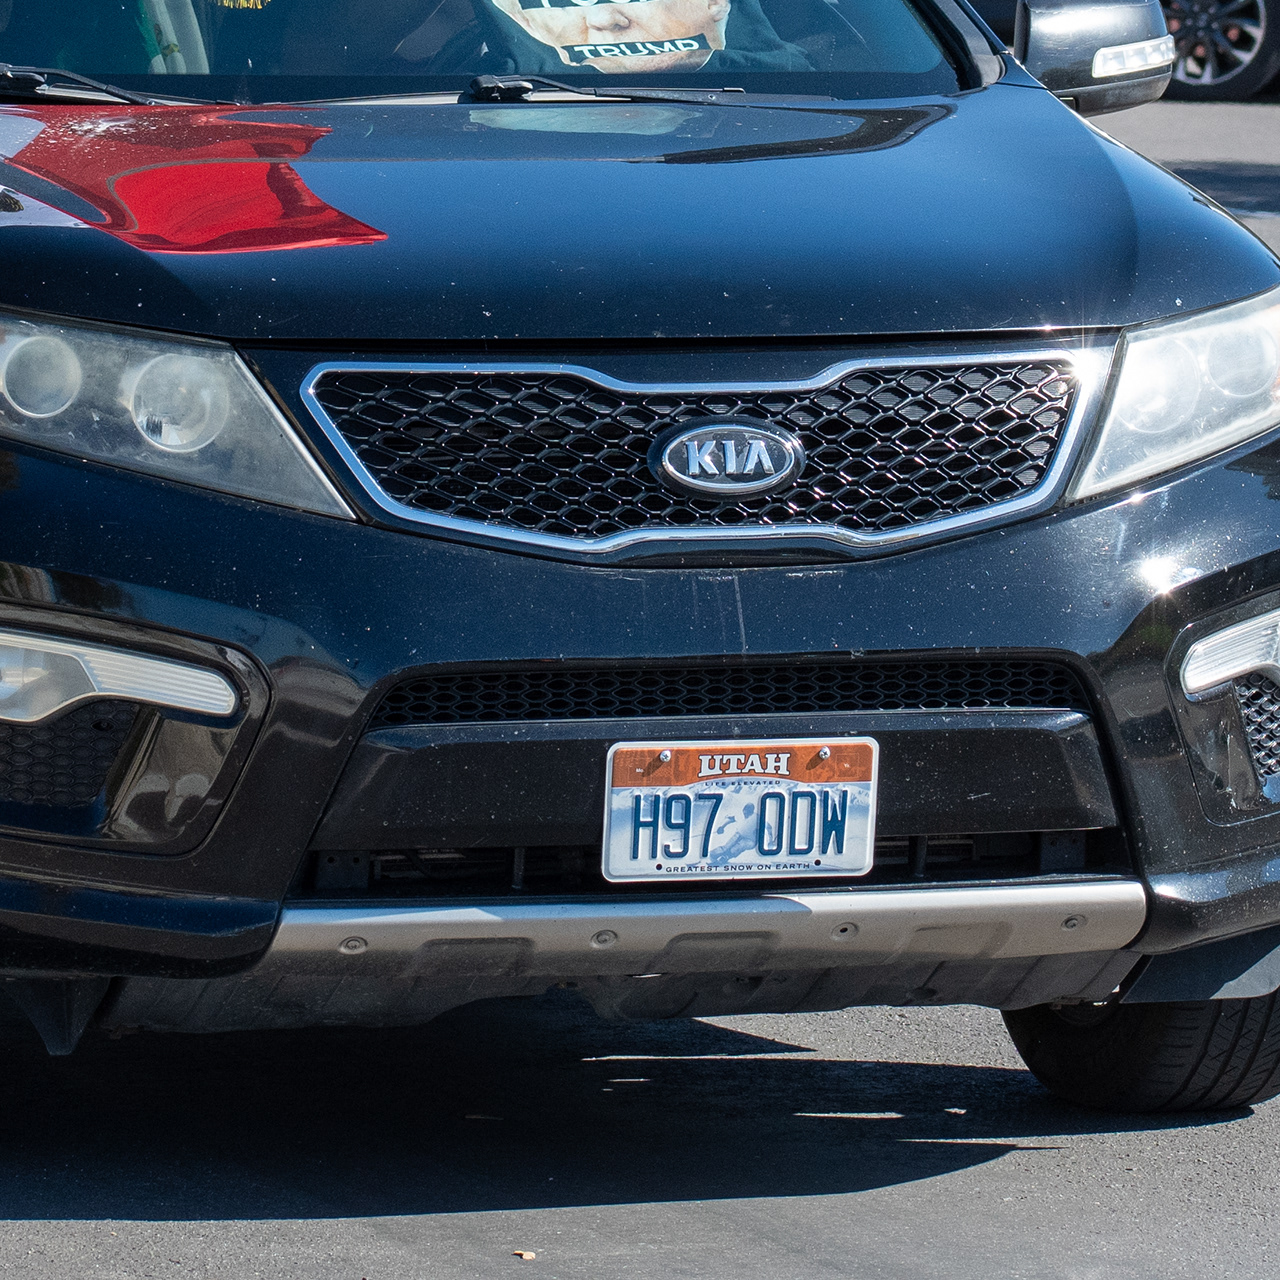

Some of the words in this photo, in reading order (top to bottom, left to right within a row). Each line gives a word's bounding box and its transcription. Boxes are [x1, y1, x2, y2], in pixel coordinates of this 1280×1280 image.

[574, 39, 700, 59] TRUMP
[685, 439, 775, 476] KIA
[698, 753, 790, 778] UTAH
[631, 792, 723, 860] H97
[665, 865, 720, 873] GREATEST
